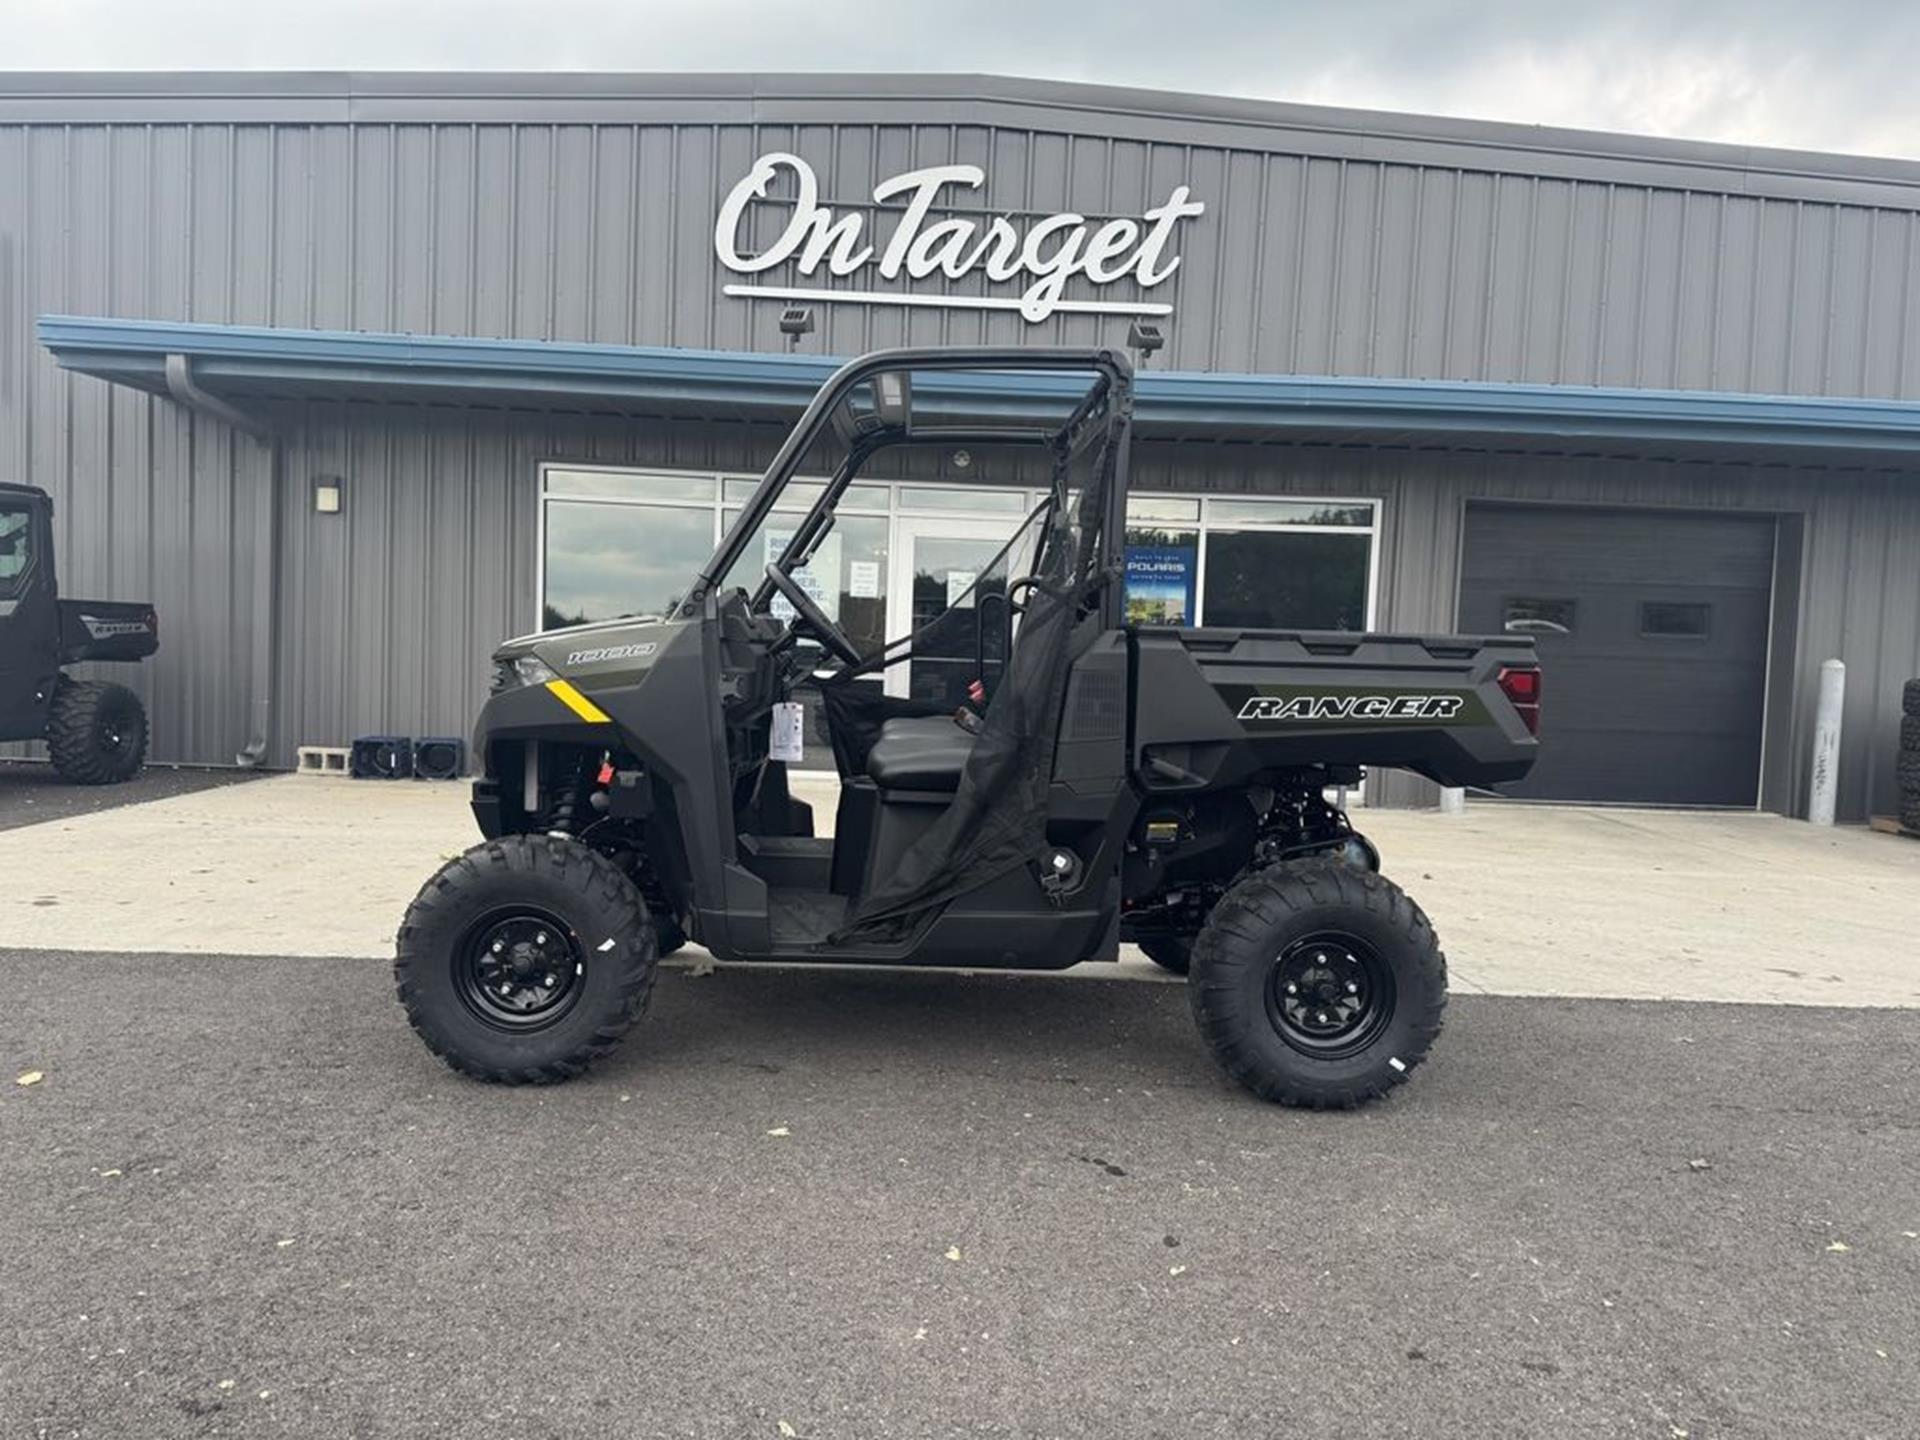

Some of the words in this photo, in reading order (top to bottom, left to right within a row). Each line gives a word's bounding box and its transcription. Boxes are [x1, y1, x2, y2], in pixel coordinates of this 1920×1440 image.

[715, 152, 874, 277] On
[874, 164, 1205, 323] Target
[1127, 562, 1186, 572] POLARIS
[1236, 695, 1463, 719] RANGER
